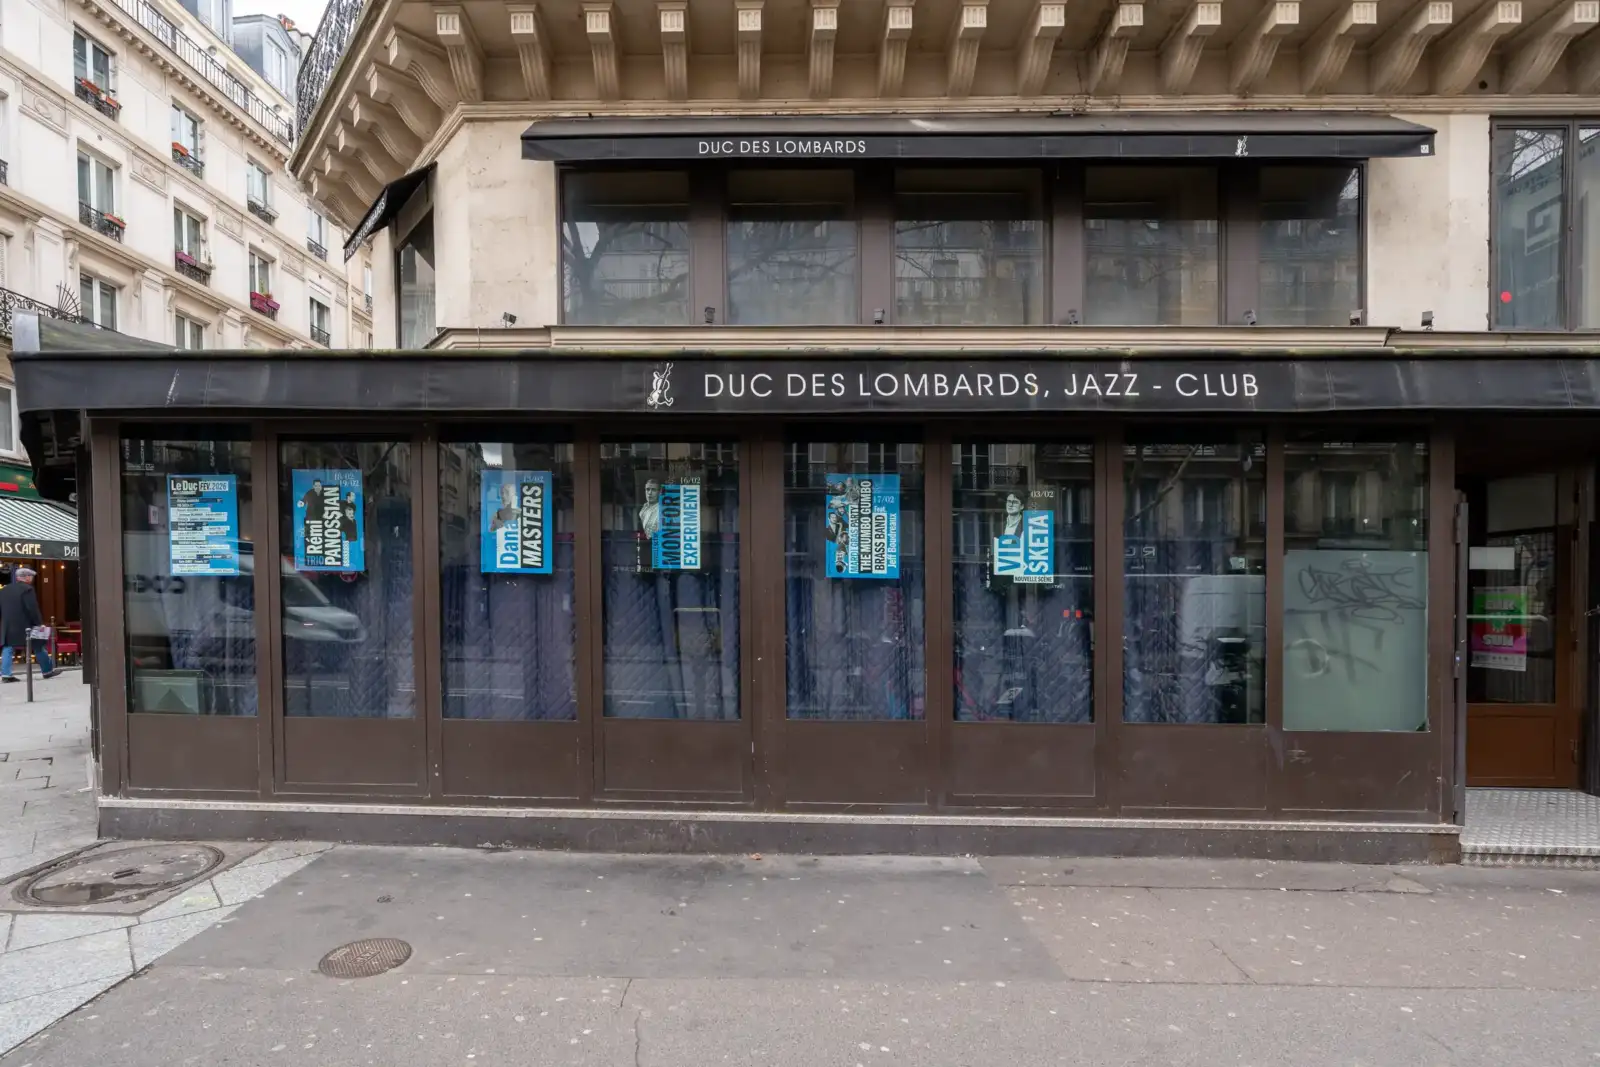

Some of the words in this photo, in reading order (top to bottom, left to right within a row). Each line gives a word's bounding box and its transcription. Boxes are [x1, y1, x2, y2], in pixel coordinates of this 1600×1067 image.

[699, 141, 733, 153] DUC
[740, 141, 770, 153] DES
[776, 140, 866, 153] LOMBARDS
[704, 373, 773, 397] DUC
[787, 373, 845, 397] DES
[859, 373, 1049, 398] LOMBARDS,
[1064, 373, 1140, 397] JAZZ
[1175, 373, 1259, 397] CLUB
[171, 479, 182, 491] Le
[182, 480, 198, 491] Duc
[860, 480, 871, 515] GUMBO
[324, 486, 342, 566] PANOSSIAN
[522, 485, 542, 567] MASTERS
[662, 485, 681, 566] MONFORT
[683, 487, 698, 566] EXPERIMENT
[850, 505, 859, 527] PARTY
[874, 515, 885, 540] BAND
[306, 520, 323, 555] Rémi
[500, 521, 519, 565] Dana
[850, 528, 859, 548] GRAS
[860, 517, 871, 553] MUMBO
[888, 513, 897, 553] Boudreaux
[1028, 514, 1049, 573] SKETA
[306, 555, 324, 566] TRIO
[860, 554, 871, 572] THE
[874, 542, 885, 571] BRASS
[888, 554, 897, 568] Jeff
